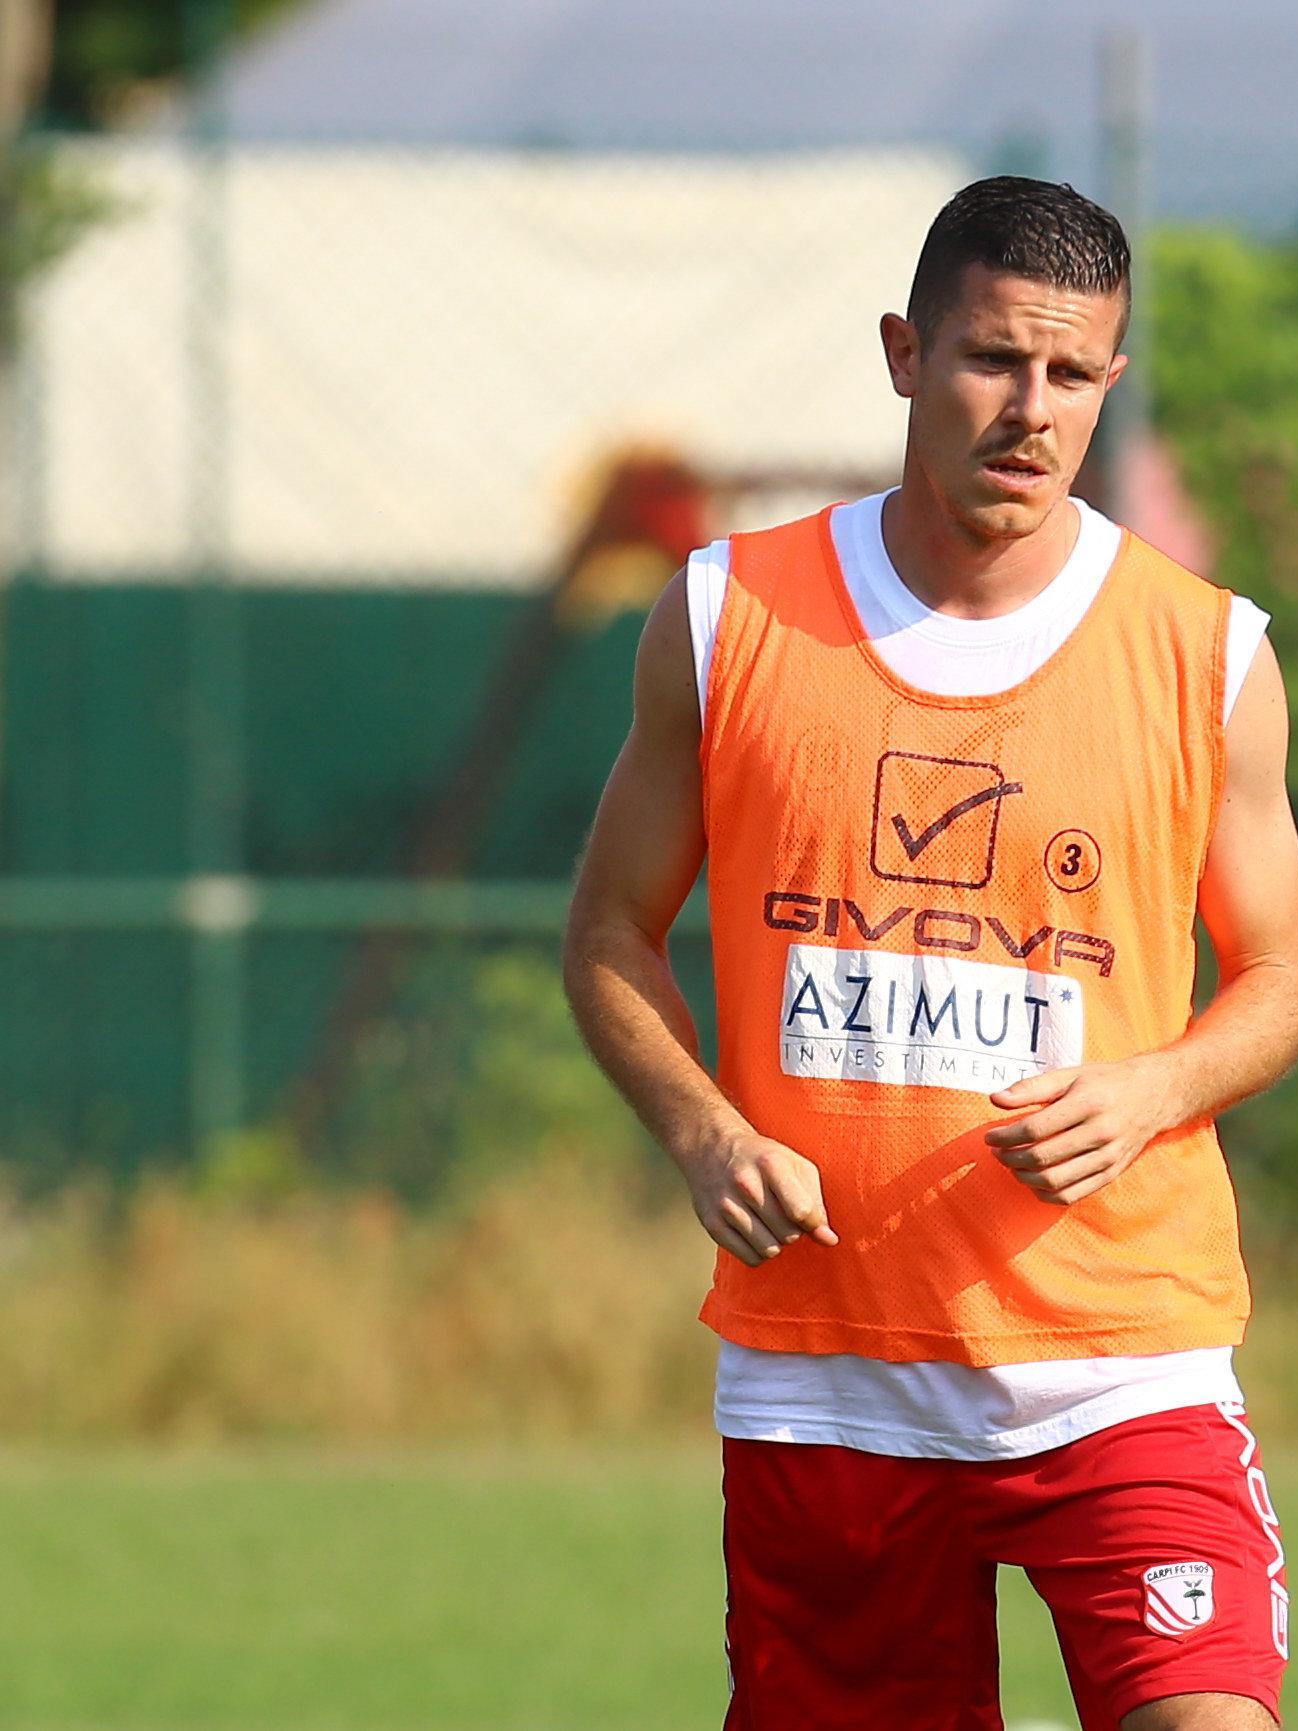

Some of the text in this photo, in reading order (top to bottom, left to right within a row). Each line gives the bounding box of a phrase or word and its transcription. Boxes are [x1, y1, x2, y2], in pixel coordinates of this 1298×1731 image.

[1060, 843, 1082, 876] 3
[763, 891, 1116, 977] GIVOVA
[786, 971, 1049, 1053] AZIMUT
[783, 1044, 1027, 1080] INVESTIMENT
[1147, 1567, 1173, 1581] CARPI
[1175, 1565, 1186, 1574] FC
